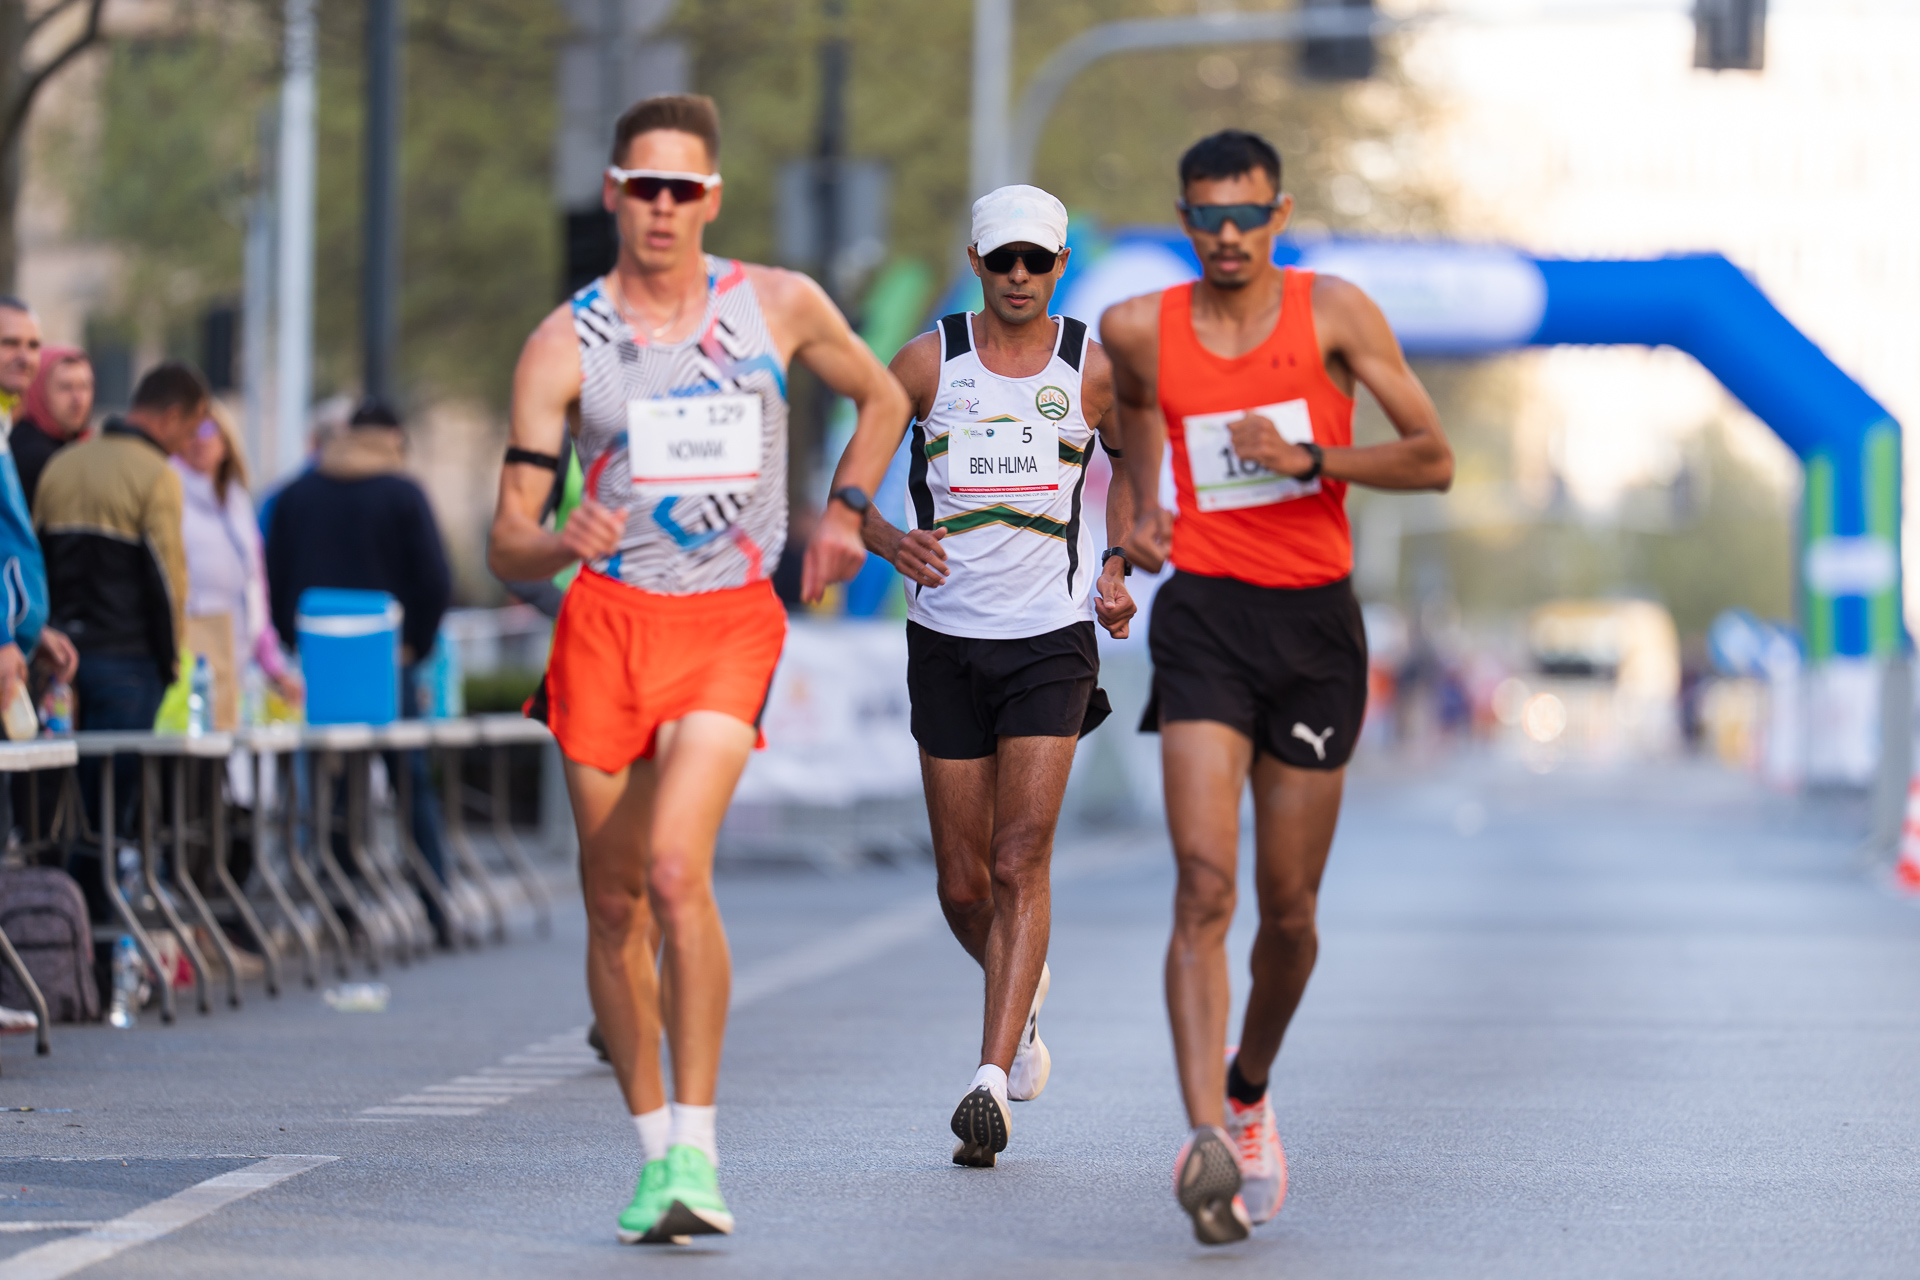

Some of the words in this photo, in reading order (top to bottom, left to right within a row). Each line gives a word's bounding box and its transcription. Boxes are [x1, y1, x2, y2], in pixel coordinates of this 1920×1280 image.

[1041, 391, 1065, 405] RKS
[708, 404, 745, 425] 129
[1022, 426, 1033, 443] 5
[970, 457, 993, 474] BEN
[999, 456, 1037, 473] HLIMA
